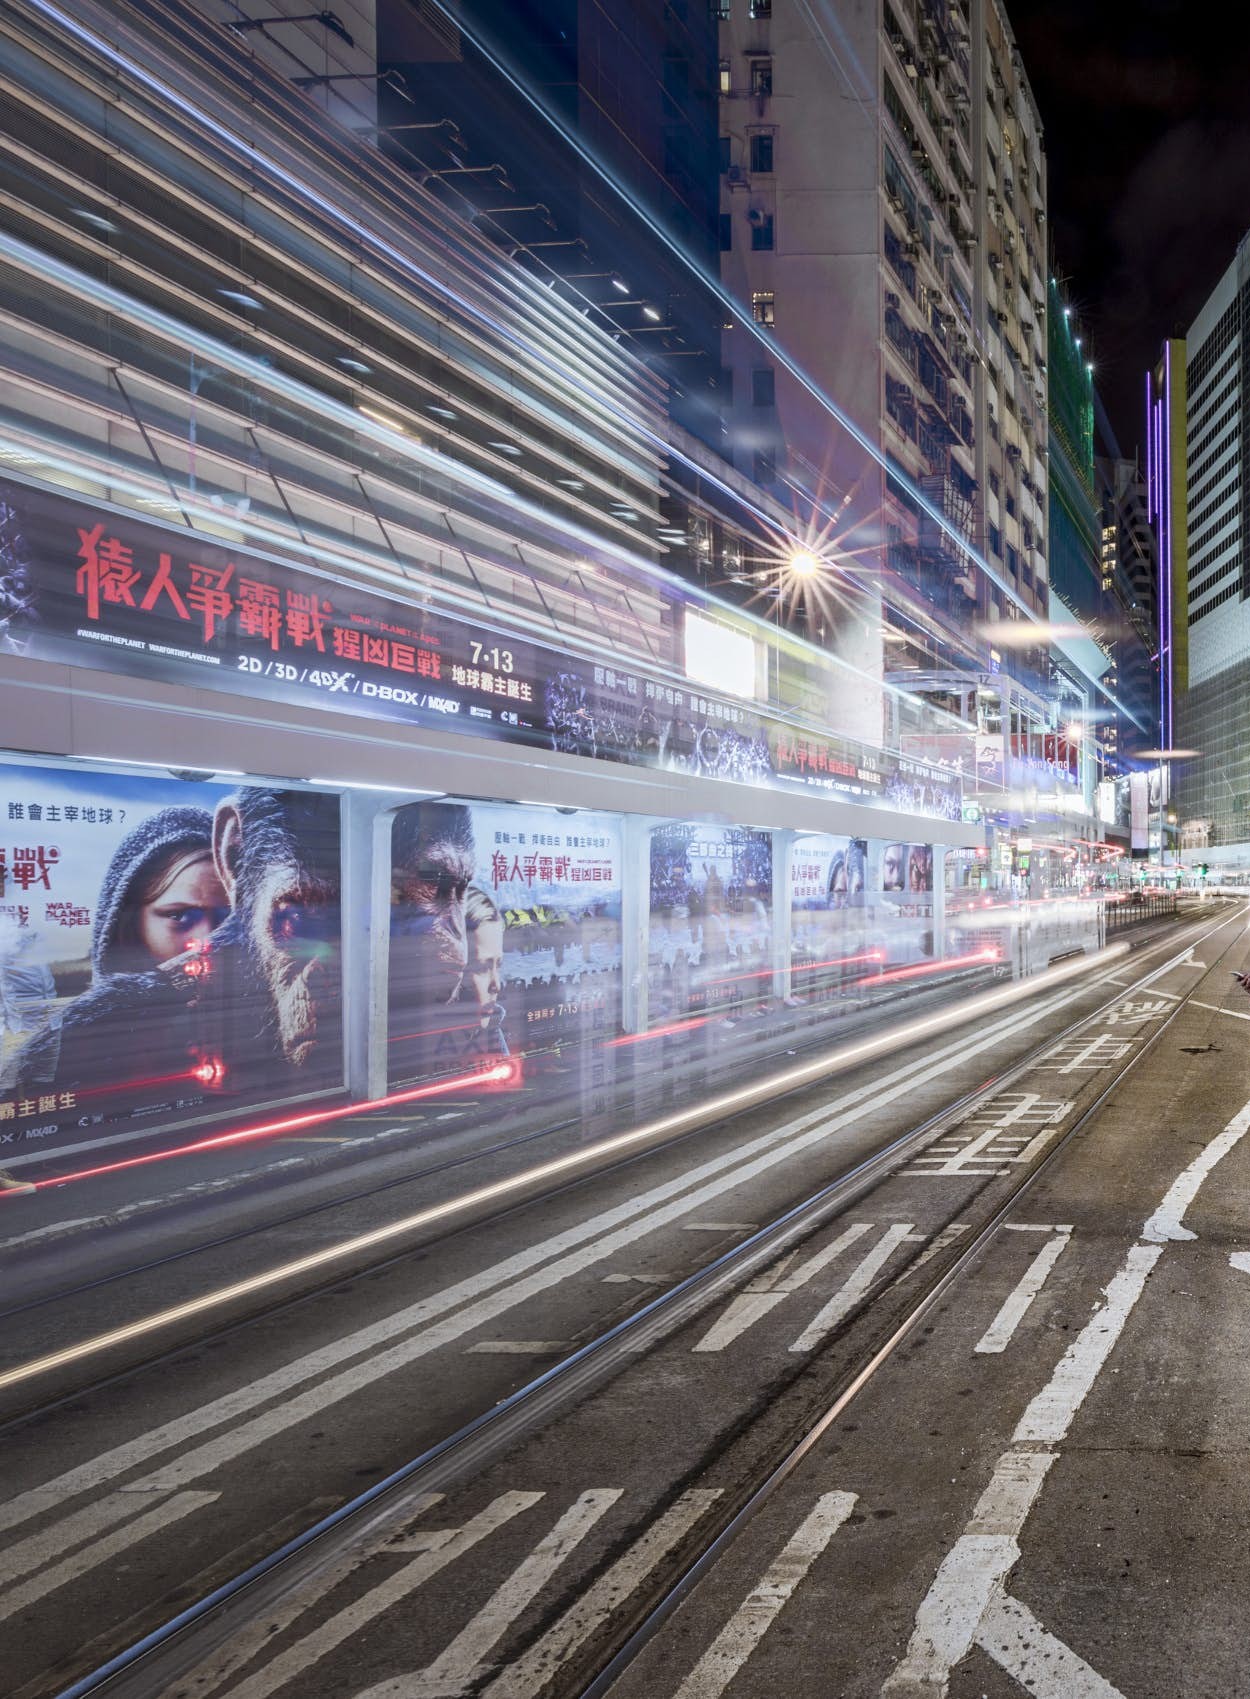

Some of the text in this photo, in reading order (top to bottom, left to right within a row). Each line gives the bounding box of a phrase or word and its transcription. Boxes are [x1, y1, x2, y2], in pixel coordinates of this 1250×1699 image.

[237, 655, 262, 674] 2D
[275, 662, 299, 681] 3D
[451, 663, 533, 702] 地球霸主誕生
